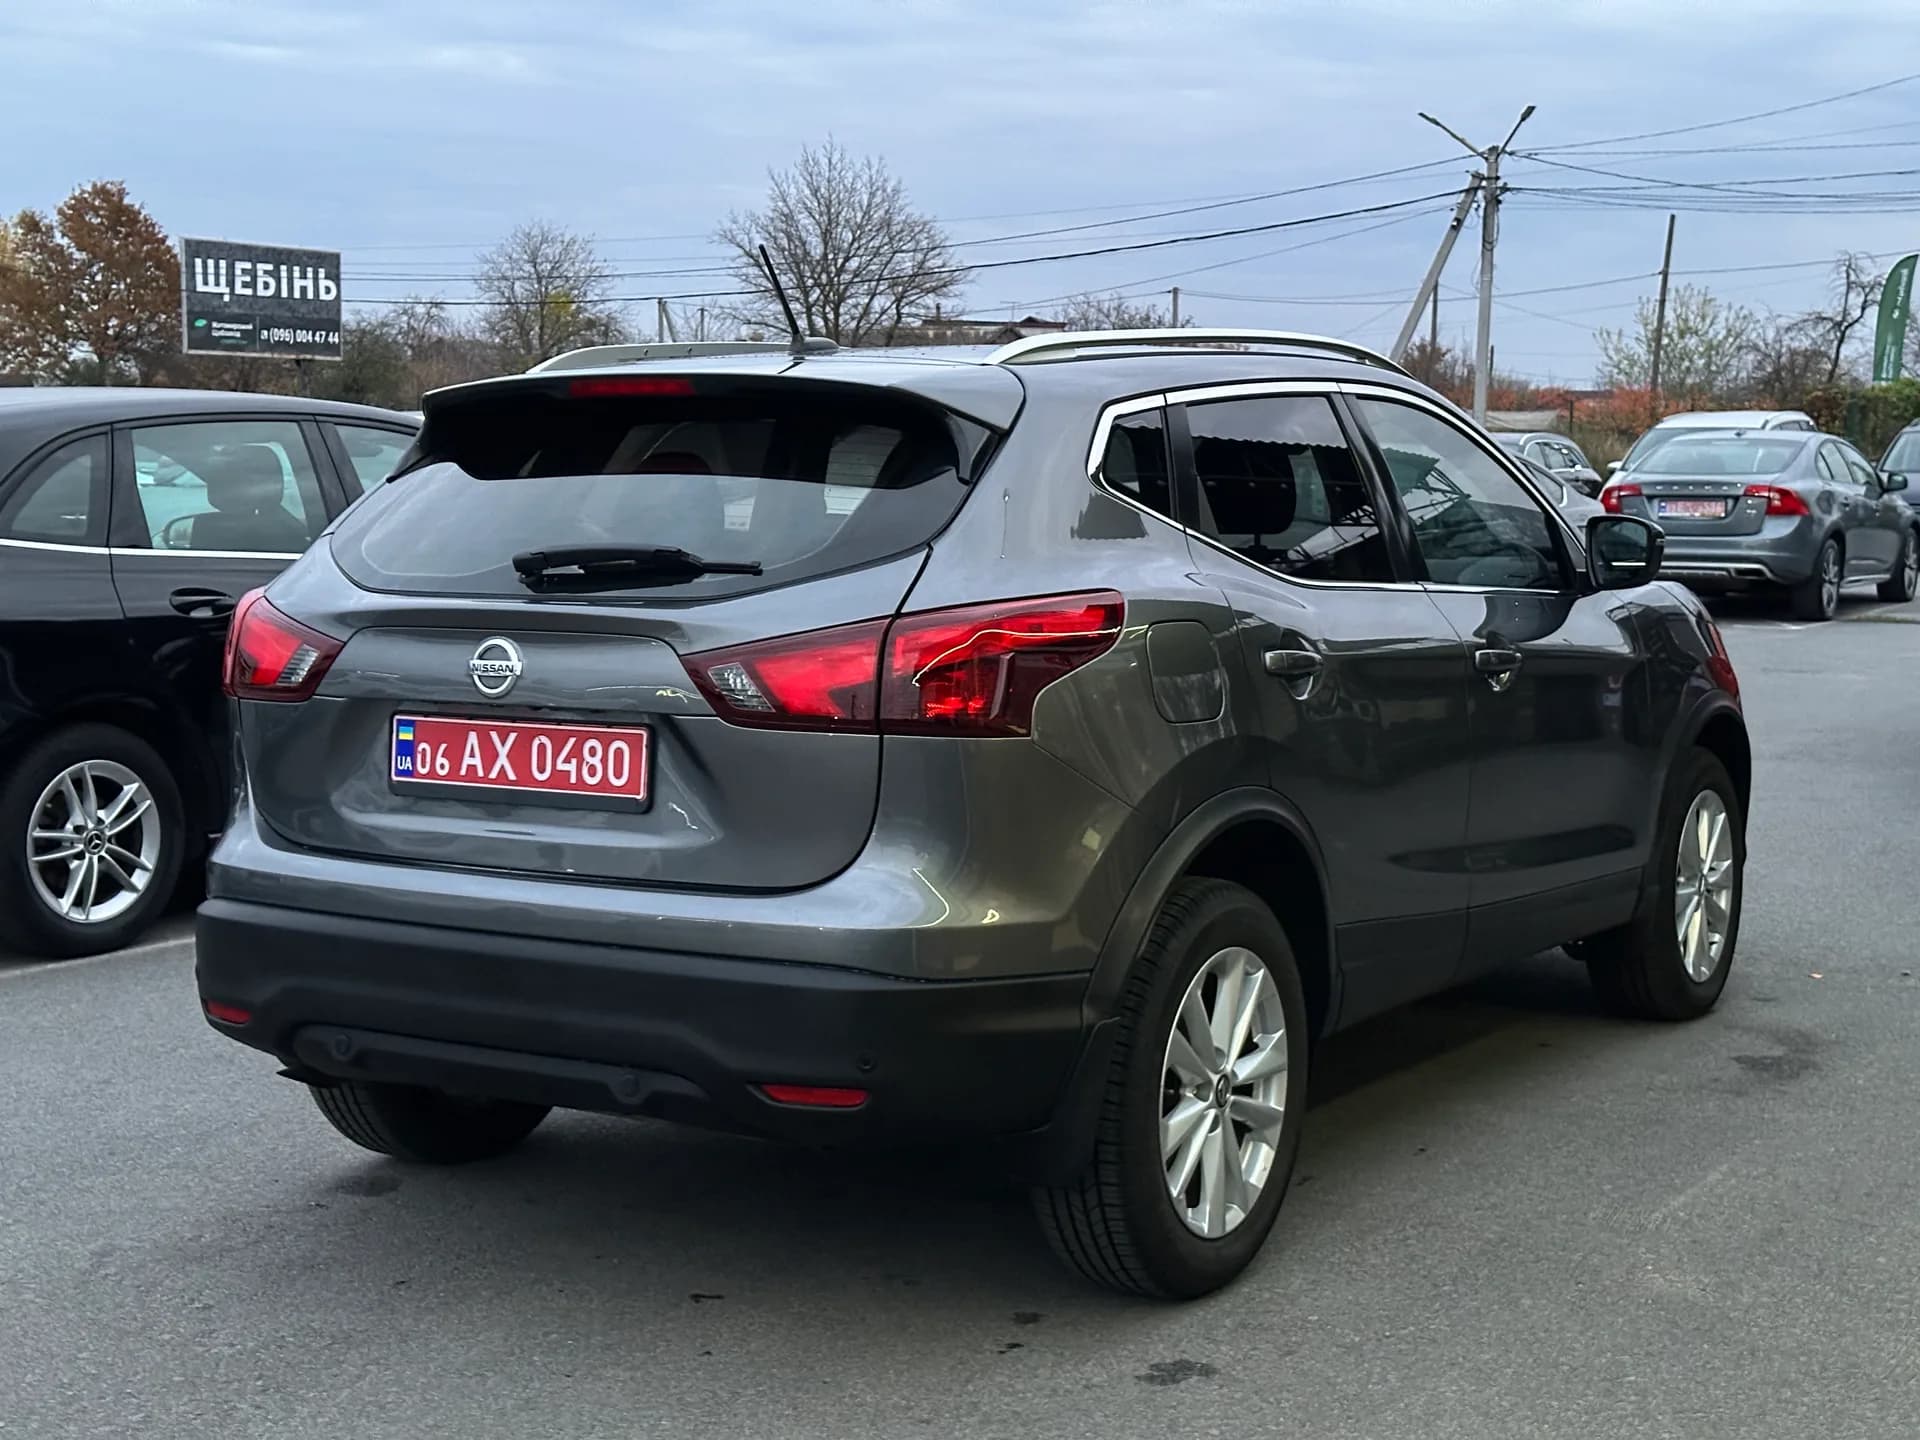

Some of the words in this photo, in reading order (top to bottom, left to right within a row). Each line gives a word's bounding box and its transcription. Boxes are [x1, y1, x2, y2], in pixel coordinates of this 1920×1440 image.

[194, 257, 338, 302] ЩЕБІНЬ
[269, 327, 294, 344] (095)
[295, 328, 313, 343] 004
[314, 330, 326, 344] 47
[327, 331, 339, 344] 44
[470, 662, 515, 674] NISSAN
[397, 755, 413, 771] UA
[416, 742, 450, 776] 06
[459, 731, 519, 781] AX
[531, 735, 630, 787] 0480
